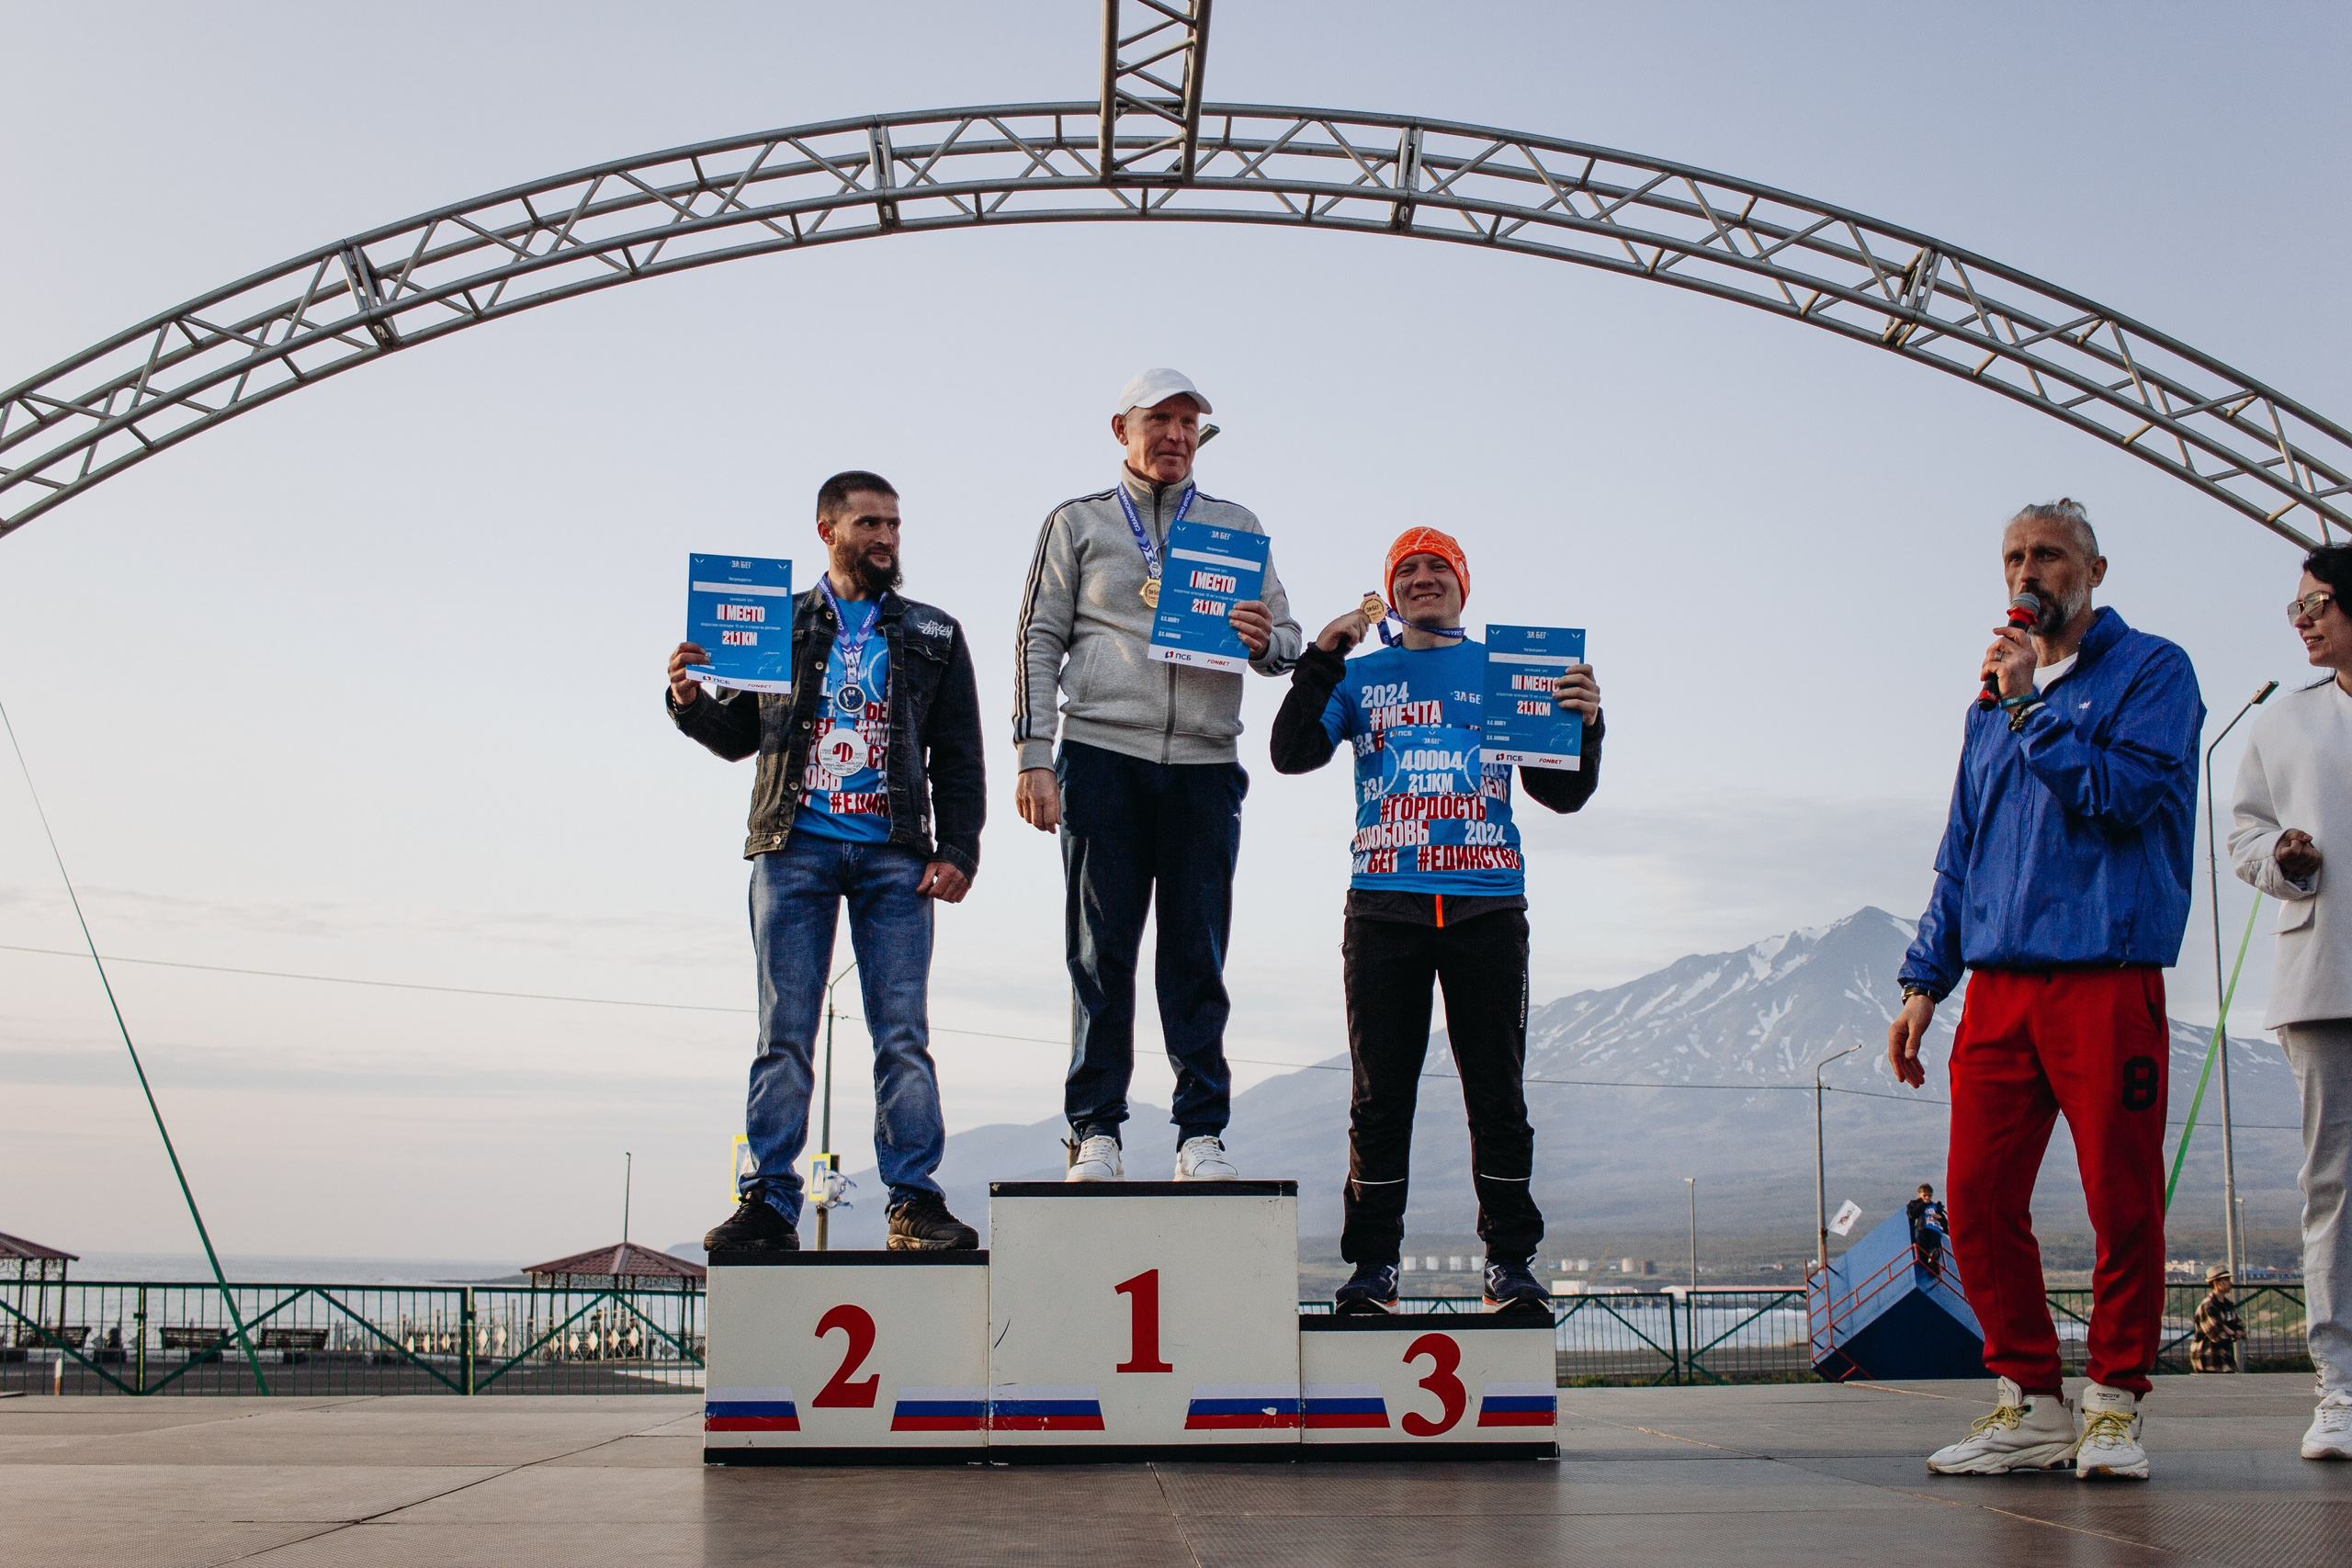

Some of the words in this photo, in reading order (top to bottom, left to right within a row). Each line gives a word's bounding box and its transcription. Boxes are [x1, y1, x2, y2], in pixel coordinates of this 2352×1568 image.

[1195, 571, 1237, 593] МЕСТО
[717, 604, 725, 620] II
[727, 604, 765, 622] МЕСТО
[1192, 598, 1209, 615] 21,1
[1210, 602, 1226, 617] КМ
[722, 630, 741, 647] 21,1
[742, 631, 758, 646] КМ
[1362, 682, 1408, 708] 2024
[1511, 674, 1521, 690] III
[1469, 693, 1481, 705] БЕ
[1517, 700, 1535, 716] 21,1
[1535, 702, 1551, 716] КМ
[1370, 701, 1442, 731] #МЕЧТА
[1400, 750, 1464, 772] 40004
[1381, 795, 1487, 822] #ГОРДОСТЬ
[1464, 820, 1507, 846] 2024
[1419, 846, 1521, 872] #ЕДИНСТВО
[2122, 1055, 2159, 1111] 8
[1114, 1269, 1173, 1373] 1
[812, 1303, 880, 1408] 2
[1401, 1333, 1466, 1438] 3
